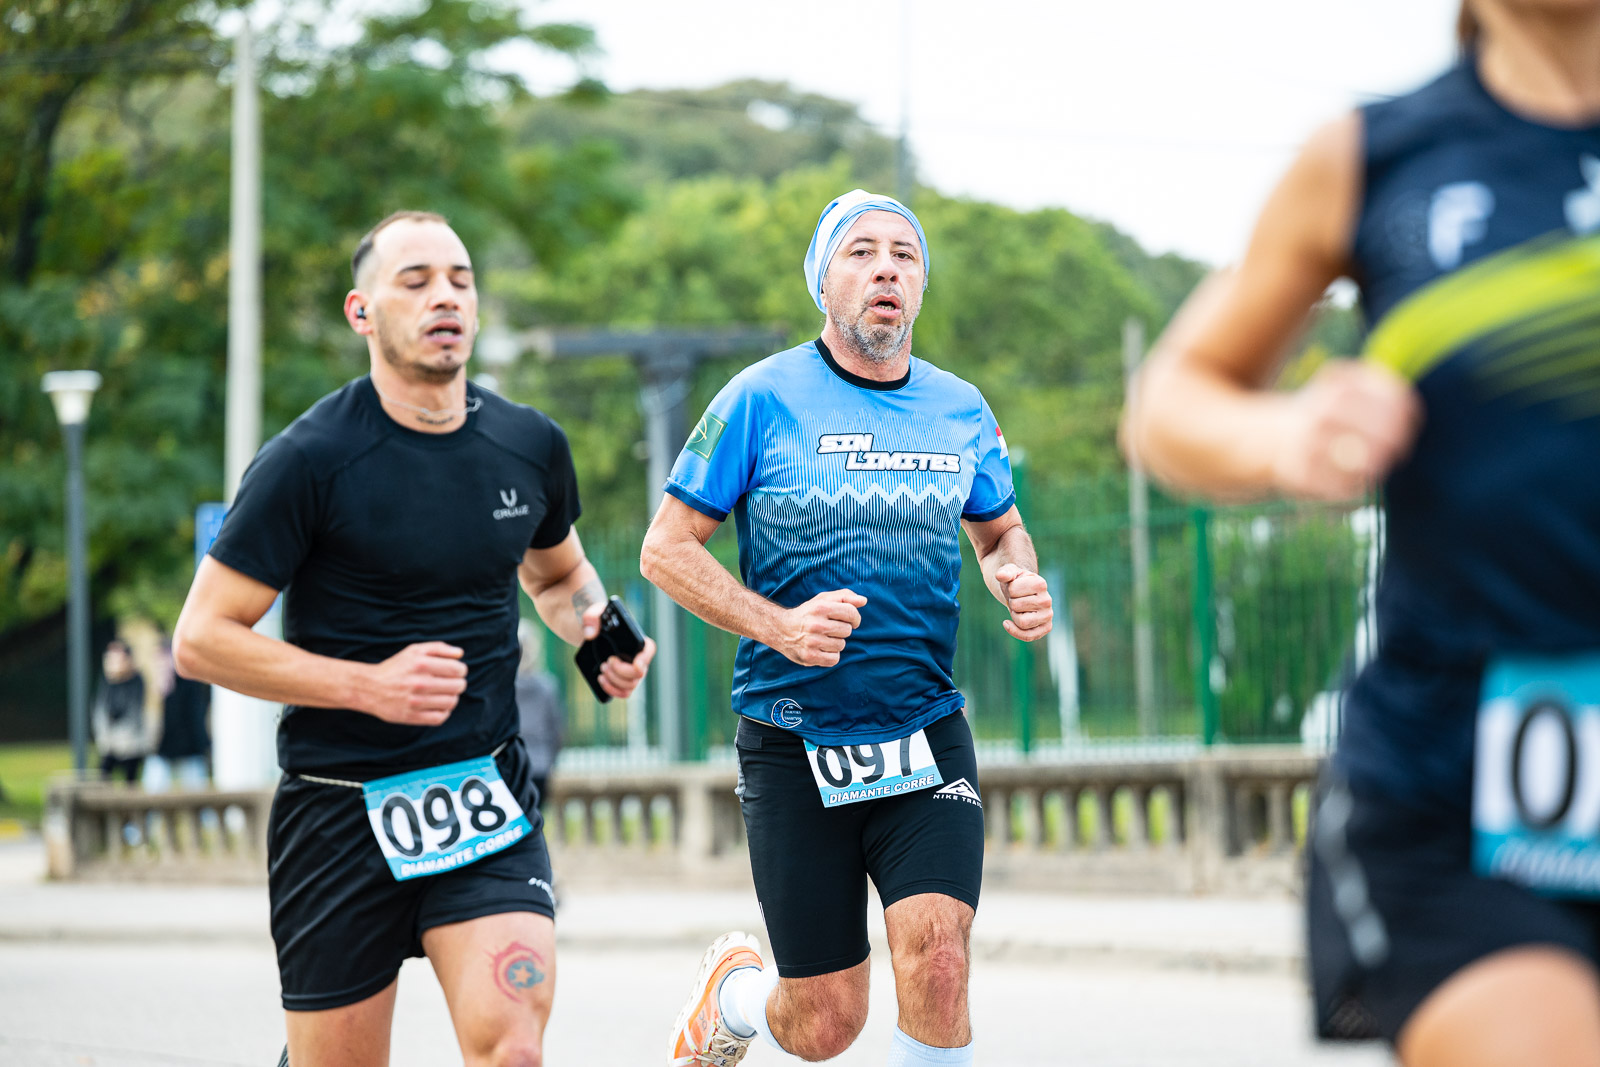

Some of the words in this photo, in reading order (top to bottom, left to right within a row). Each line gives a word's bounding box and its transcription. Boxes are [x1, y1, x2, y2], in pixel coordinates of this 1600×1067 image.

[817, 433, 874, 454] SIN
[845, 451, 961, 473] LIMITES
[828, 785, 891, 804] DIAMANTE
[893, 774, 935, 792] CORRE
[933, 793, 958, 801] NIKE
[381, 778, 507, 858] 098
[400, 846, 474, 877] DIAMANTE
[475, 824, 524, 856] CORRE
